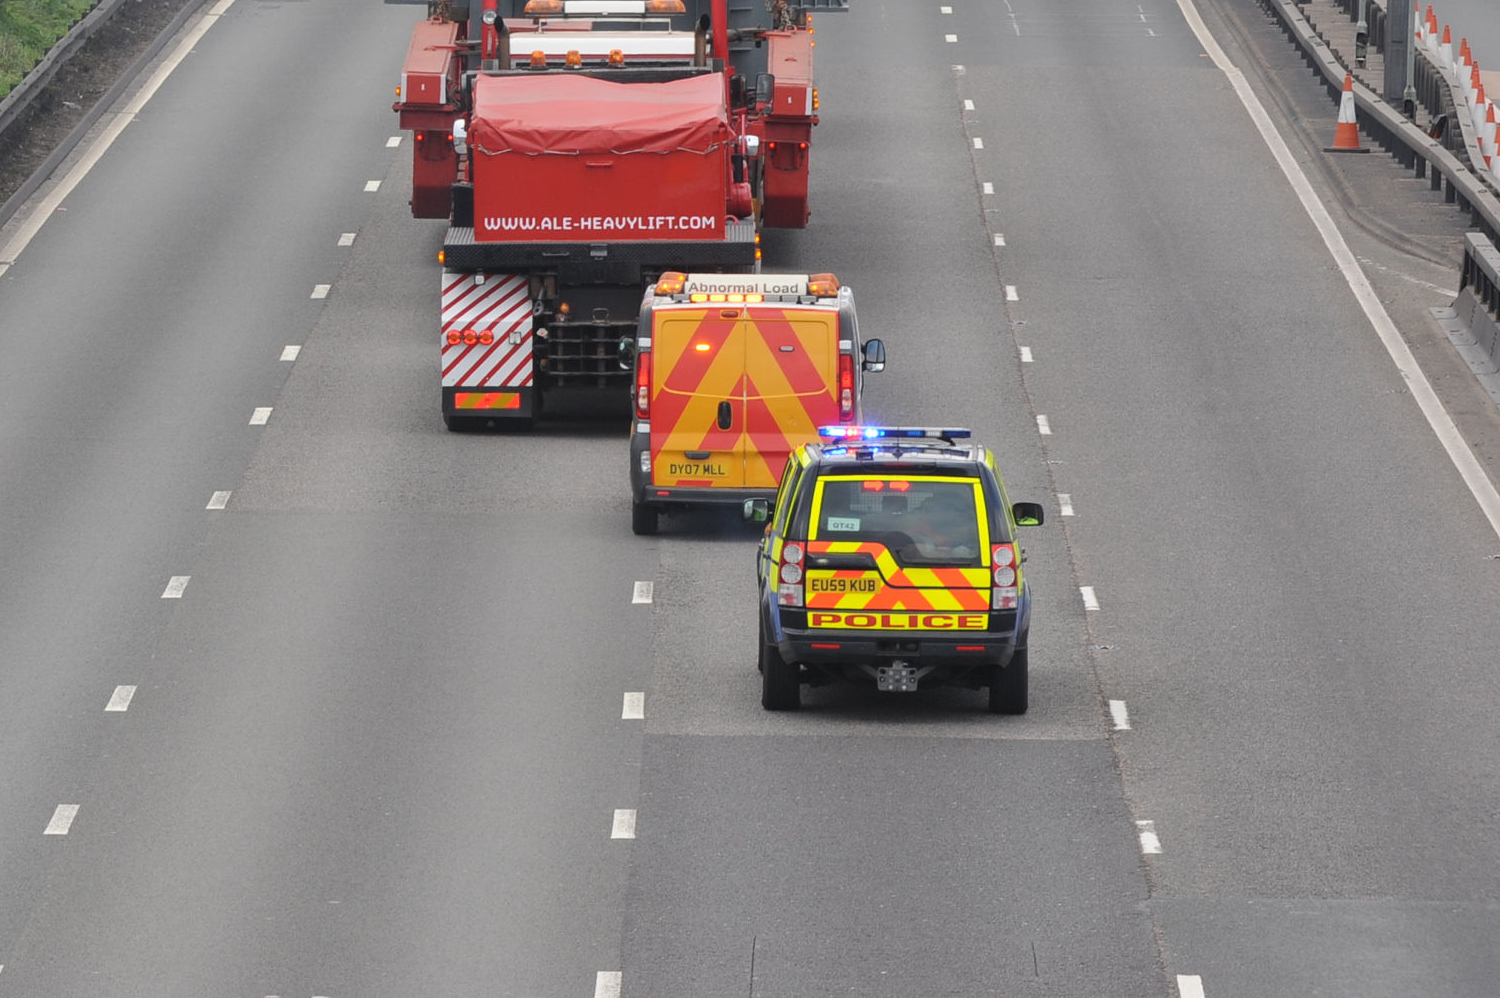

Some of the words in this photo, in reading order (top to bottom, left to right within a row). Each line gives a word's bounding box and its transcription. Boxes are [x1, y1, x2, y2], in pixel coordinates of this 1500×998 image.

[484, 215, 716, 232] WWW.ALE-HEAVYLIFT.COM
[688, 281, 760, 294] Abnormal
[763, 282, 799, 294] Load
[670, 463, 700, 476] DY07
[811, 579, 847, 592] EU59
[850, 579, 876, 592] KUB
[812, 613, 984, 628] POLICE
